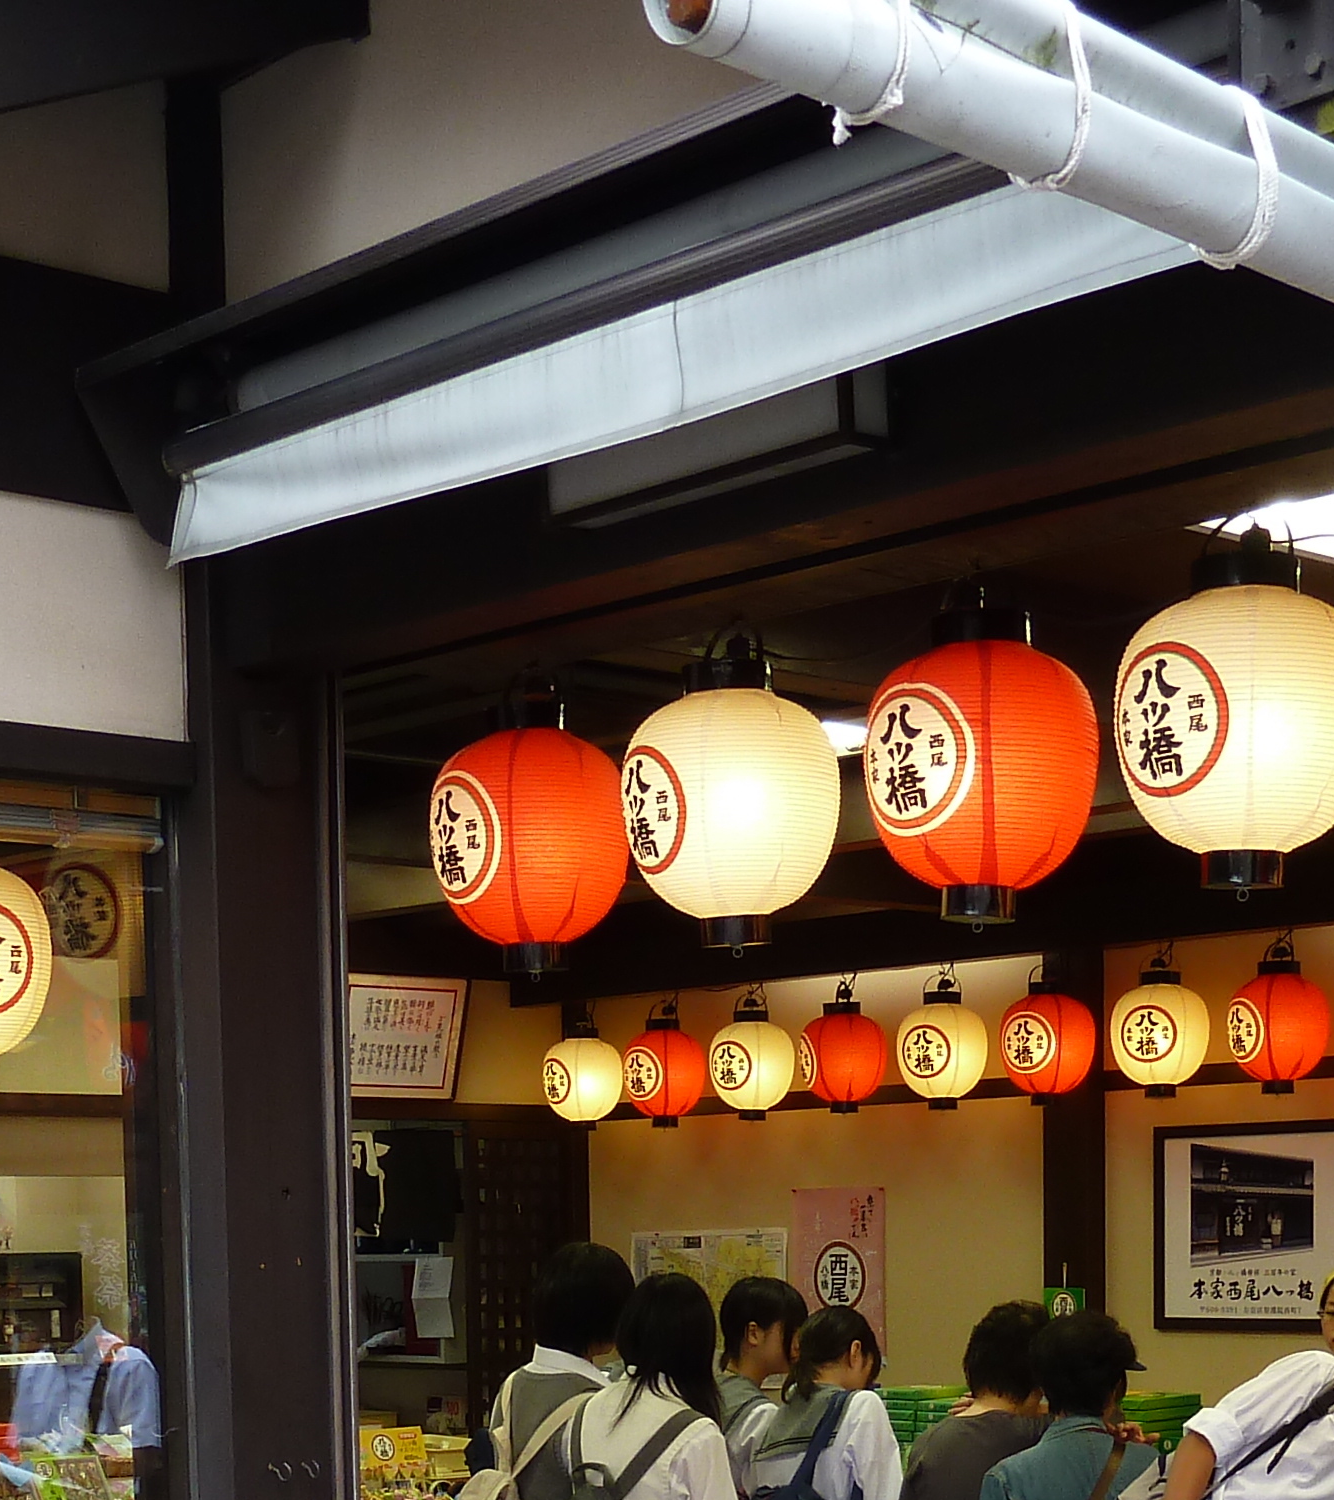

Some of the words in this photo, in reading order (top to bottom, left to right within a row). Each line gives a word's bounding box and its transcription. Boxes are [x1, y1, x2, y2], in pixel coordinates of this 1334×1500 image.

[1187, 693, 1208, 733] 西尾
[928, 733, 948, 768] 西尾
[655, 790, 671, 823] 西尾
[465, 819, 480, 849] 西尾
[828, 1254, 849, 1302] 西尾
